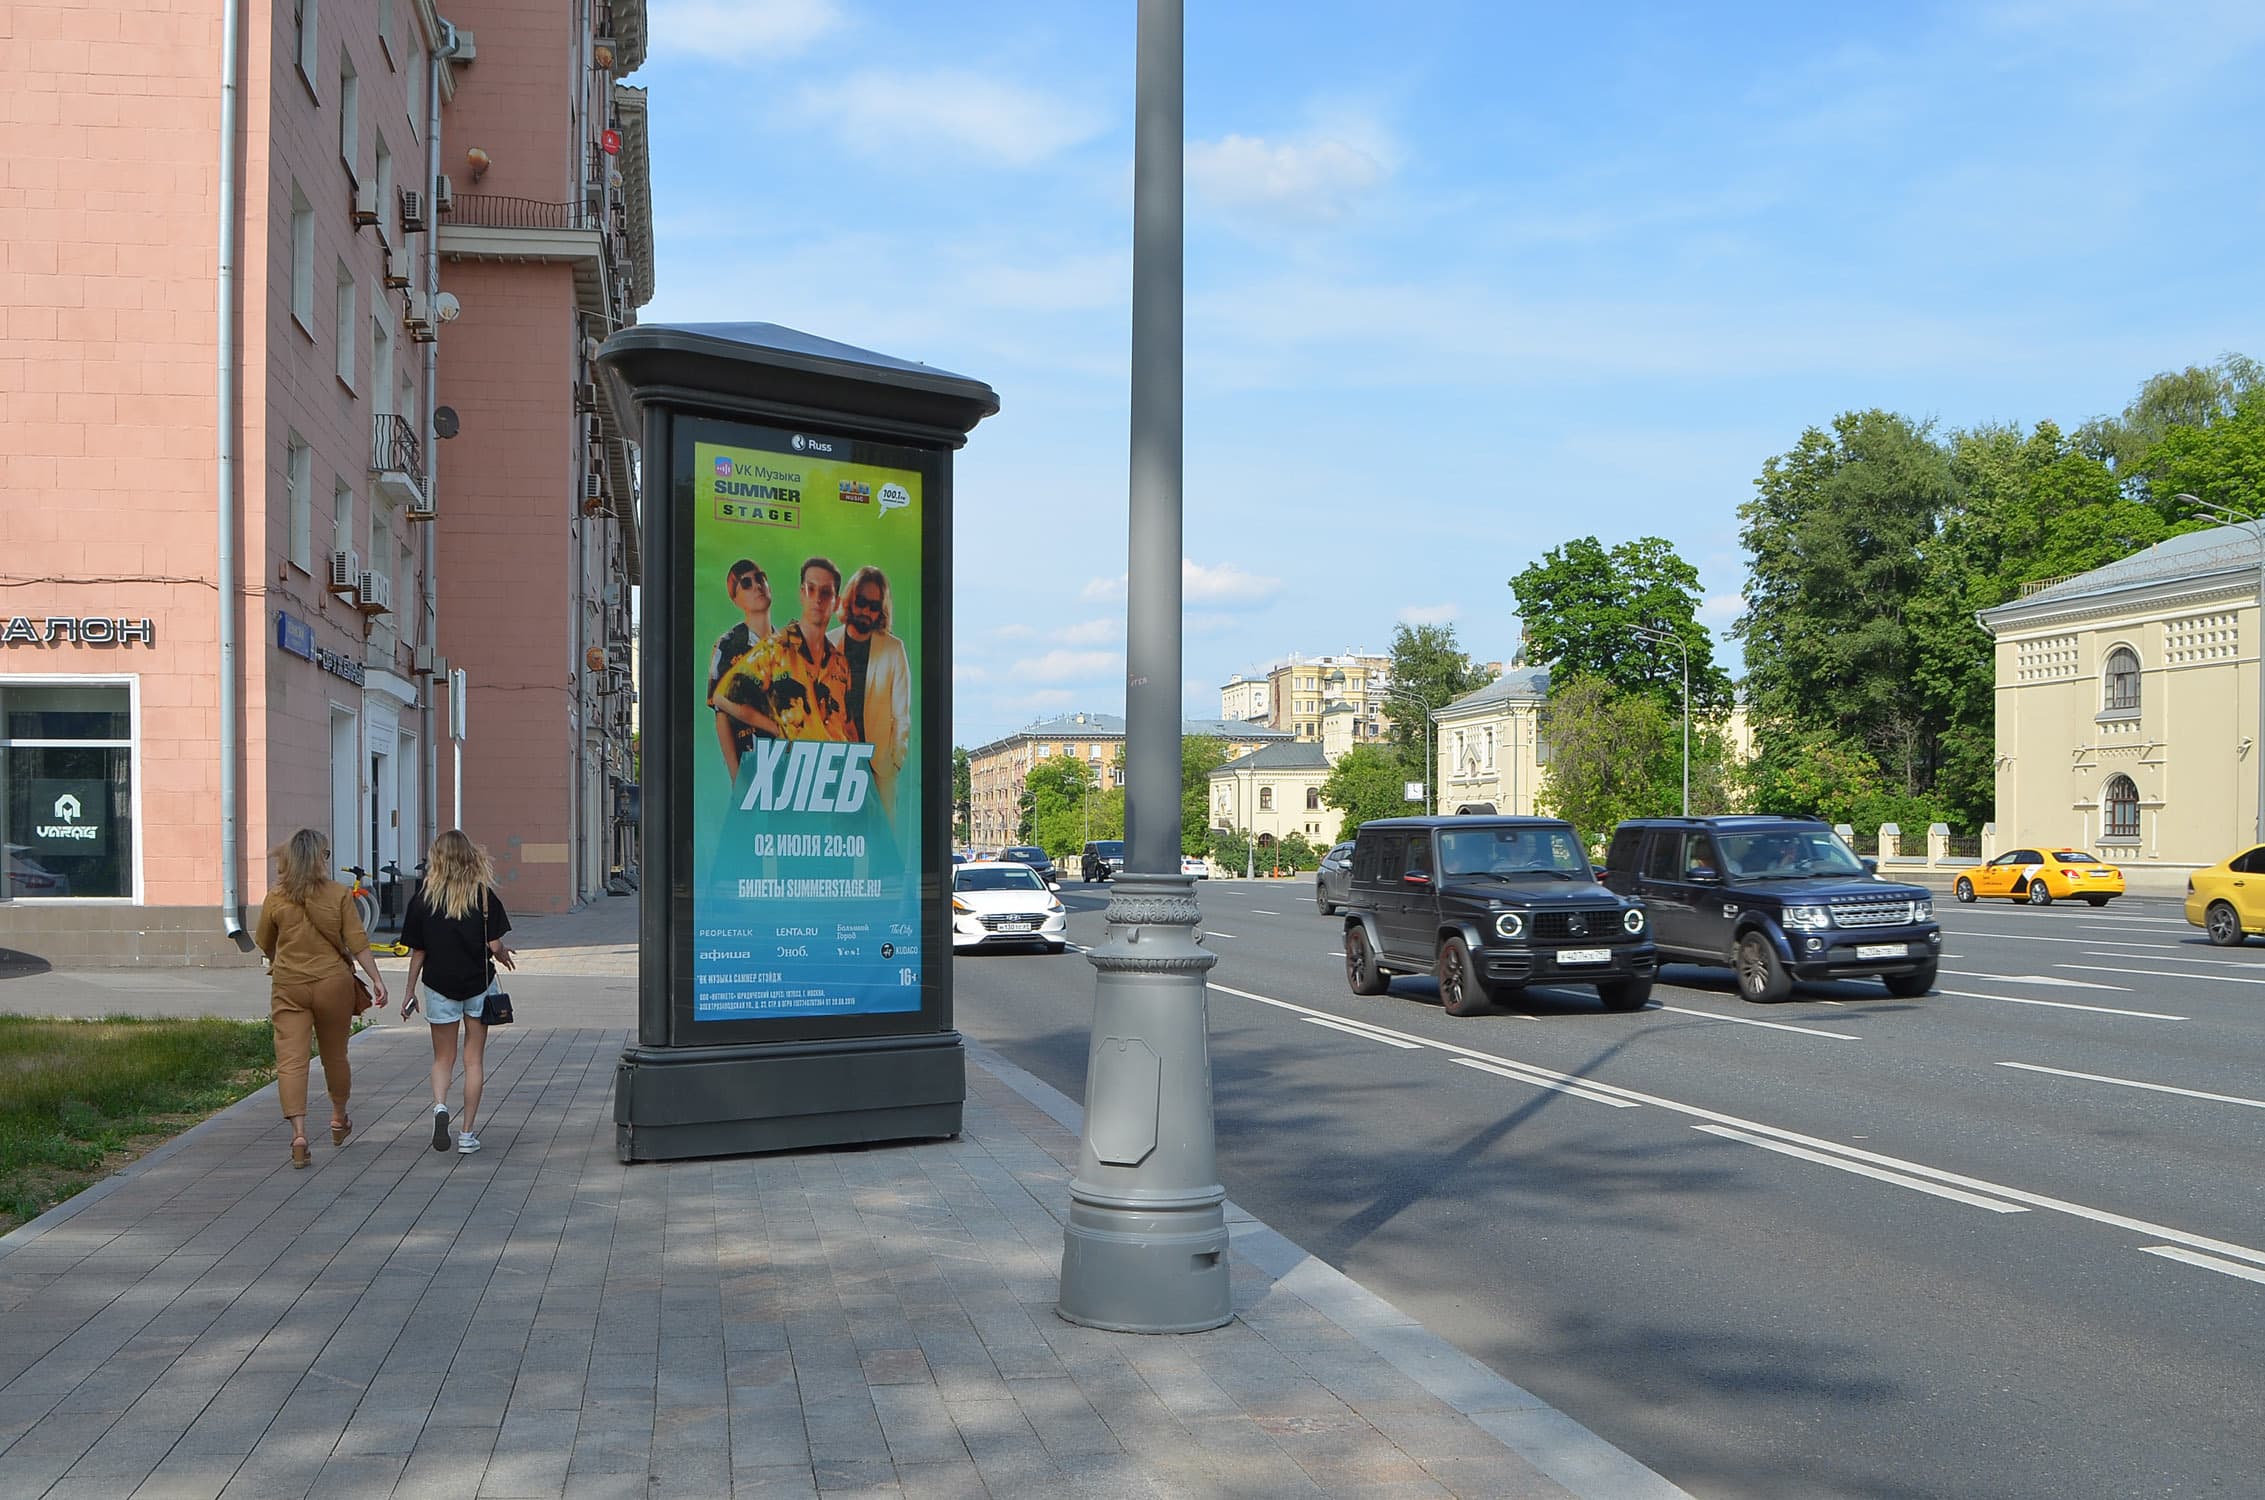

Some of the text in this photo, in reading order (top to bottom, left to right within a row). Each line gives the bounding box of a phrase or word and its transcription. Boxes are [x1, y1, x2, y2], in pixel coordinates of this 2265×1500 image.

[809, 439, 832, 453] Russ
[735, 463, 801, 483] VK Музыка
[714, 480, 801, 503] SUMMER
[723, 504, 793, 522] STAGE
[1, 616, 152, 643] АЛОН
[740, 738, 875, 813] ХЛЕБ
[36, 825, 99, 841] VARAG
[755, 834, 865, 857] 02 ИЮЛЯ 20:00
[738, 879, 881, 898] БИЛЕТЫ SUMMERSTAGE.RU
[699, 929, 753, 937] PEOPLETALK
[776, 927, 818, 937] LENTA.RU
[699, 949, 751, 961] афиша
[899, 967, 917, 986] 16+
